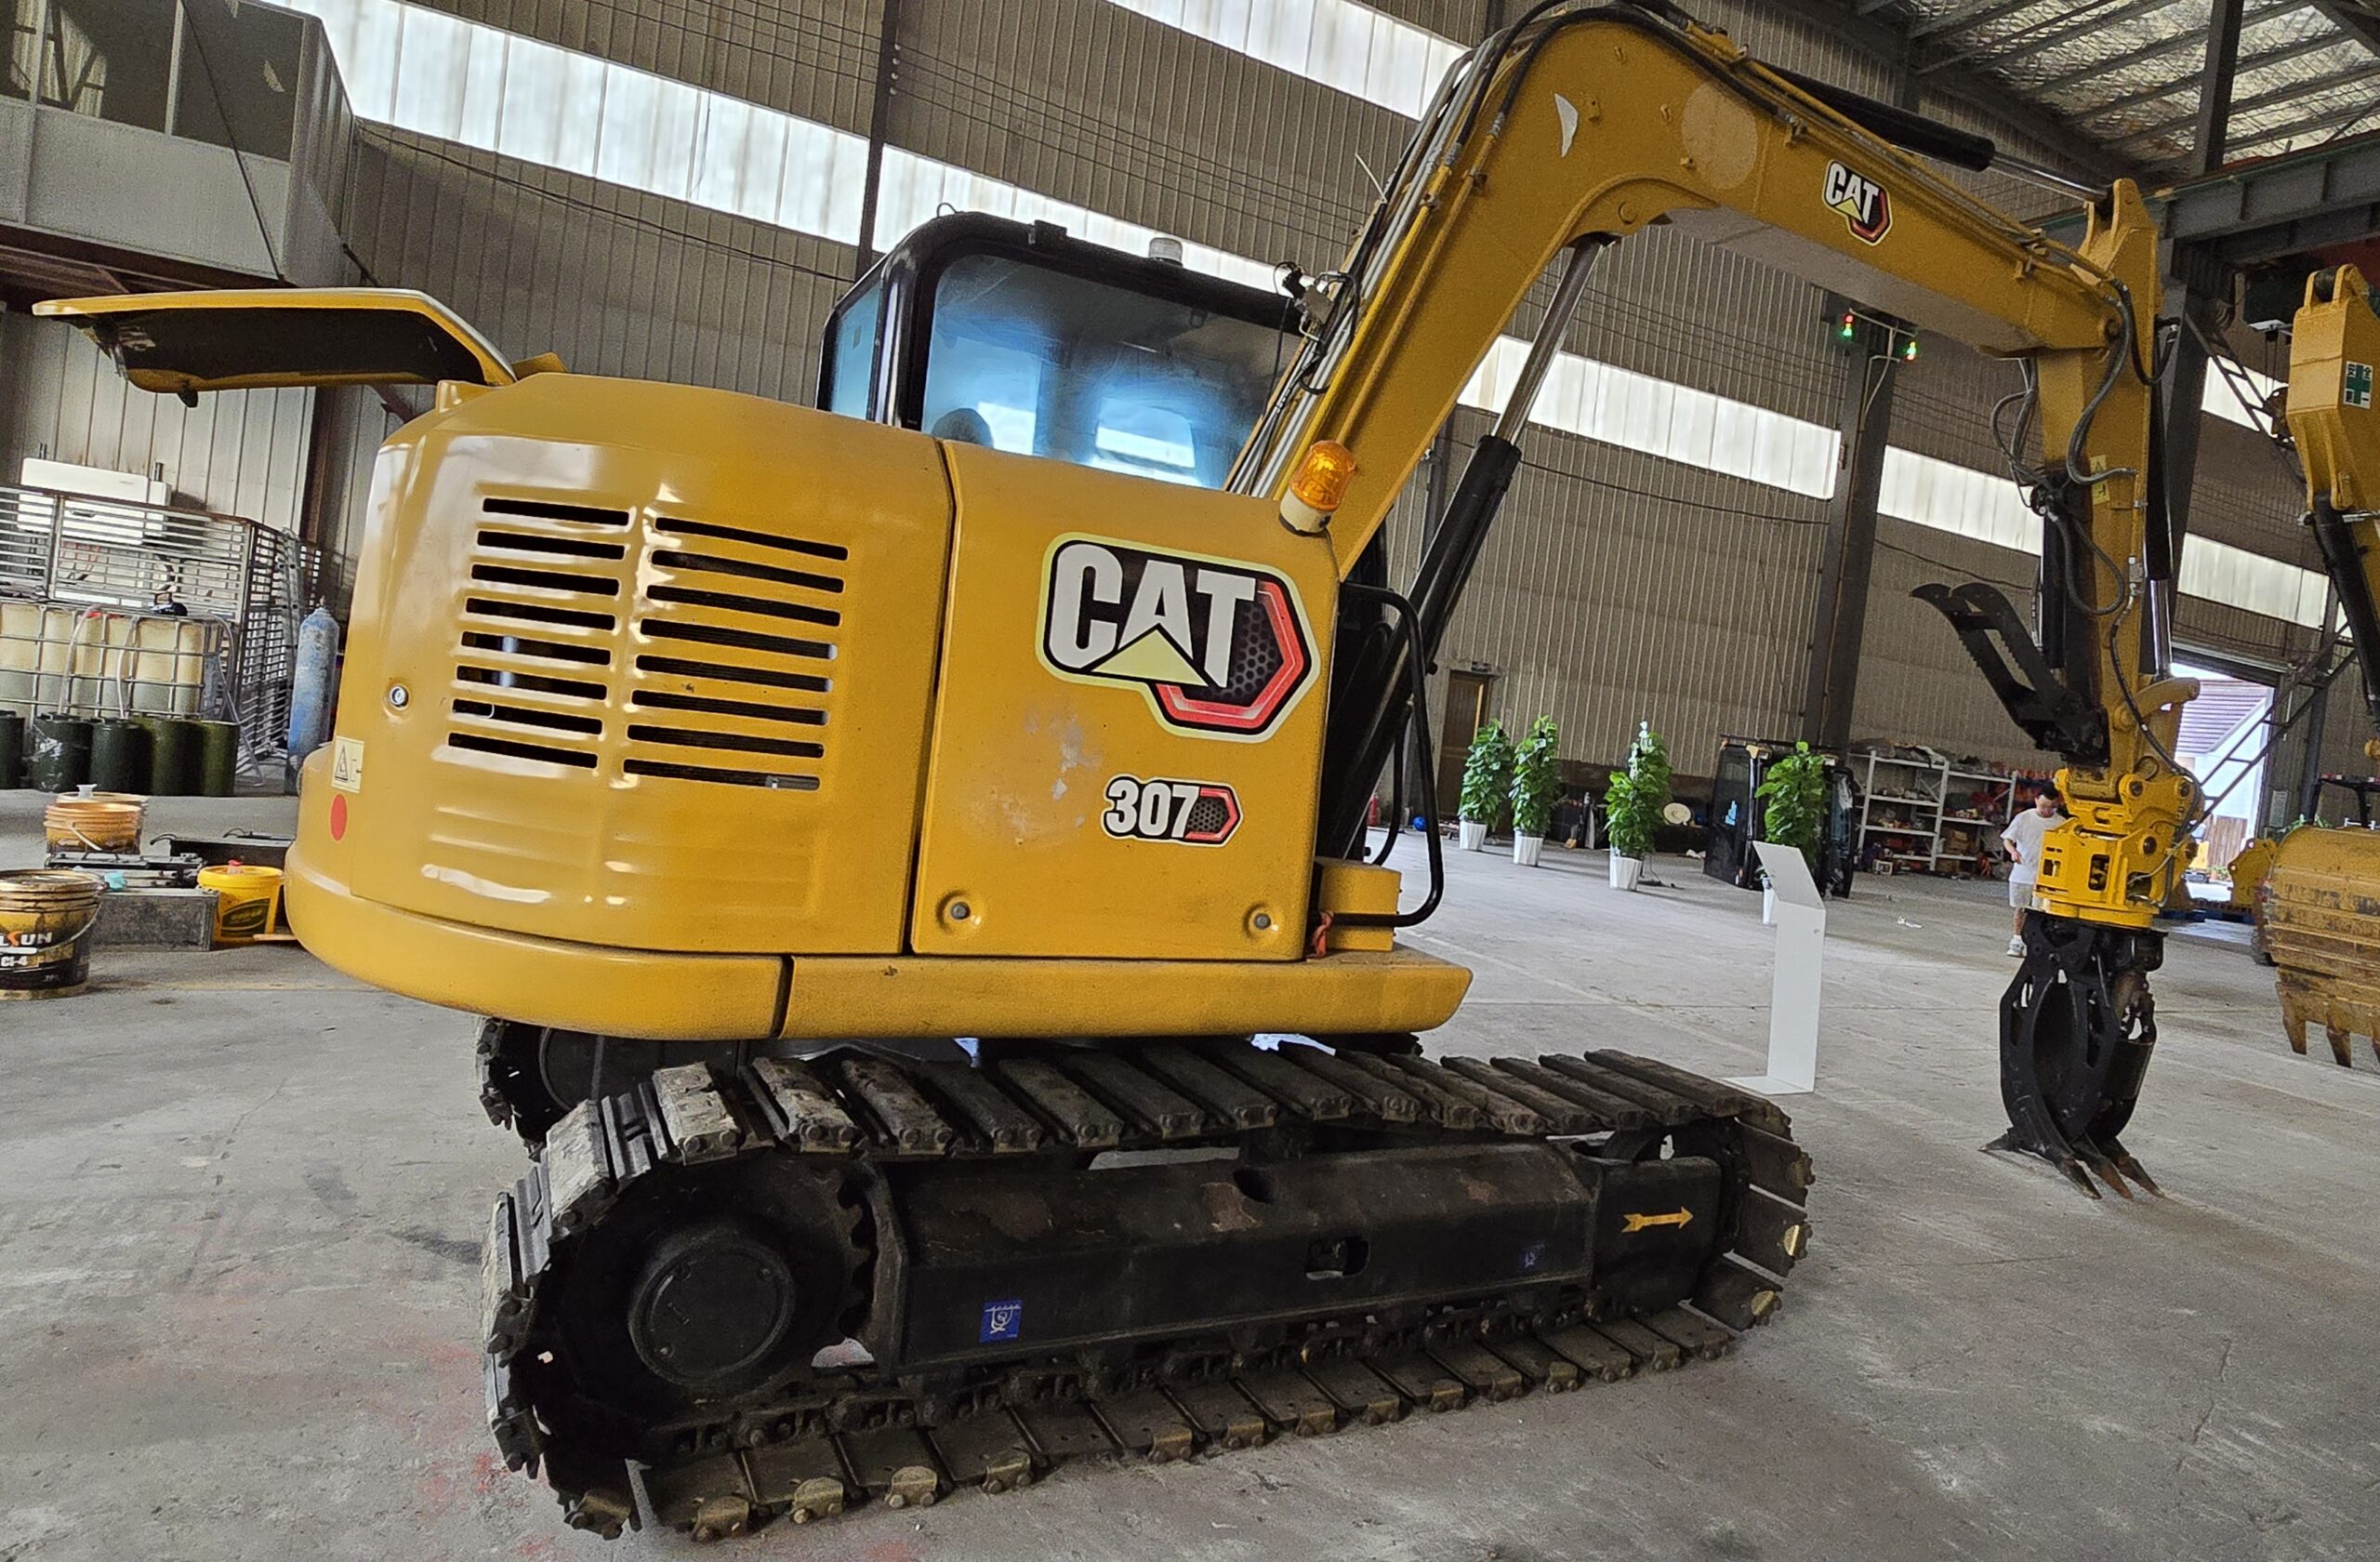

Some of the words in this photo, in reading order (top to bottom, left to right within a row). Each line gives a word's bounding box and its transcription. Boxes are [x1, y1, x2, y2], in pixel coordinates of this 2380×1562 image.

[1825, 162, 1880, 224] CAT
[1049, 543, 1256, 688] CAT
[1106, 779, 1200, 838] 307
